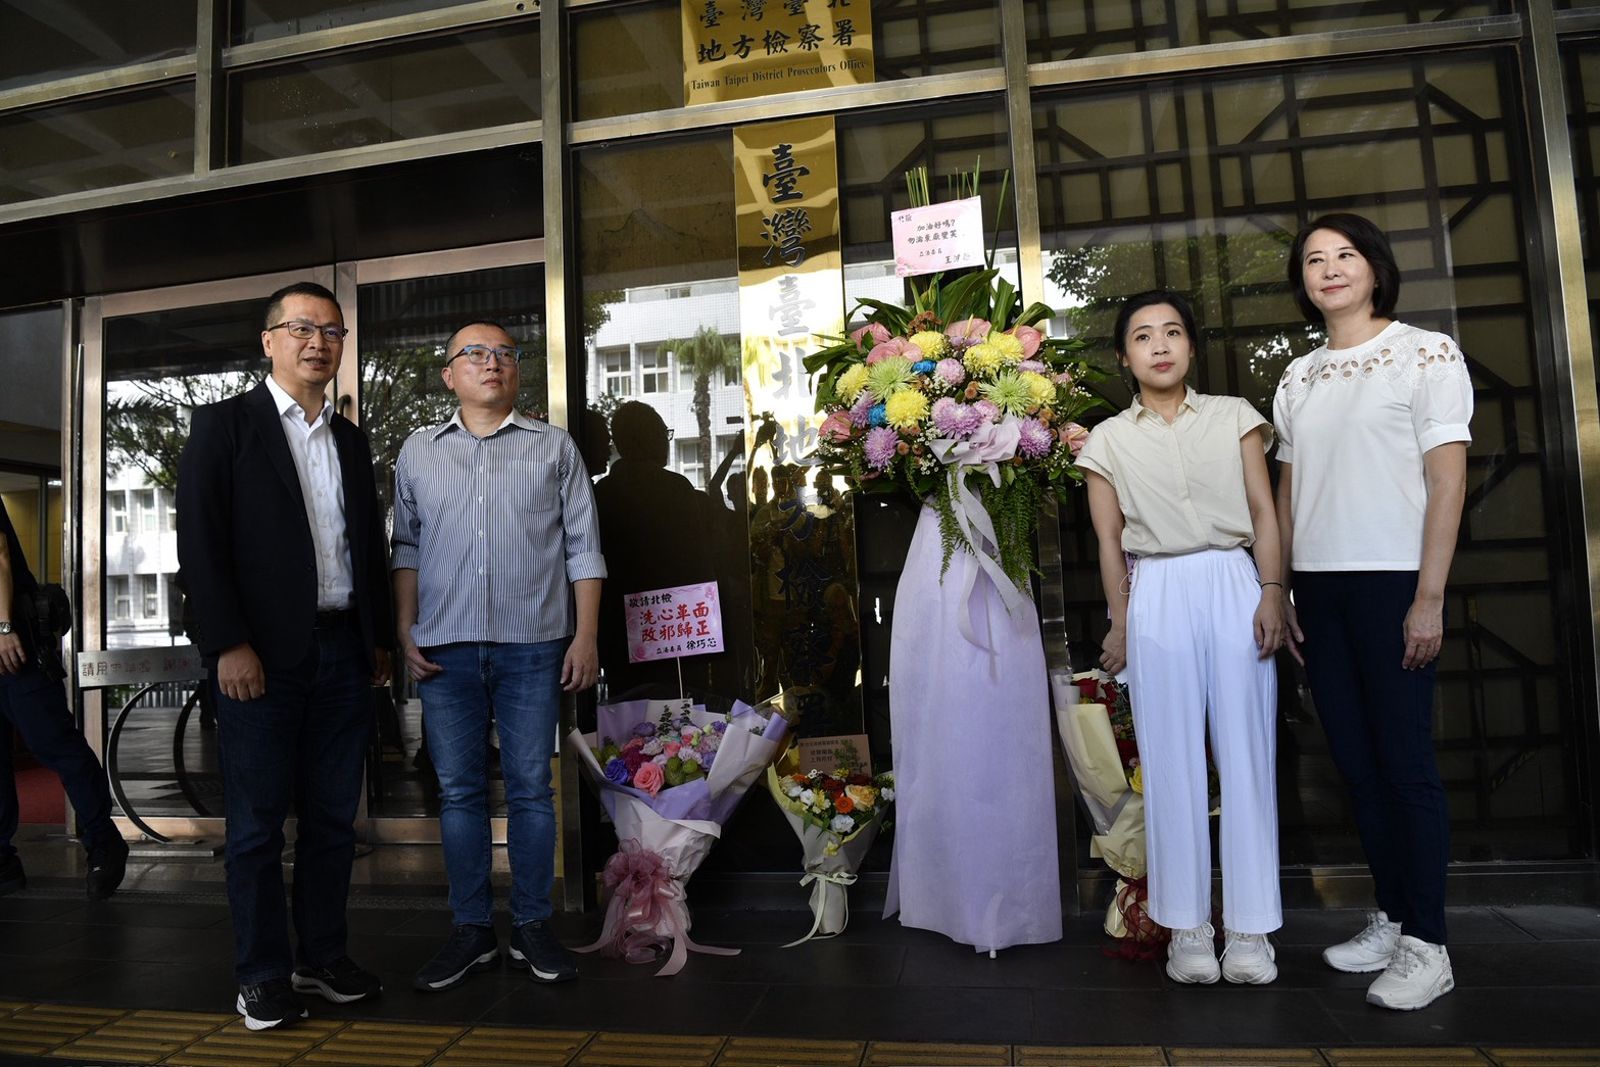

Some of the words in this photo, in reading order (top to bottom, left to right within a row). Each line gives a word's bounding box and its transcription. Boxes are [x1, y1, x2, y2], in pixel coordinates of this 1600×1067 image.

[698, 19, 856, 63] 地方檢察署
[691, 79, 721, 90] Taiwan
[724, 74, 749, 87] Taipei
[752, 69, 784, 82] District
[788, 62, 836, 78] Prosecutors
[840, 59, 867, 71] Office
[640, 601, 710, 625] 洗心革面
[641, 620, 710, 642] 改邪歸正
[686, 637, 717, 650] 徐巧芯
